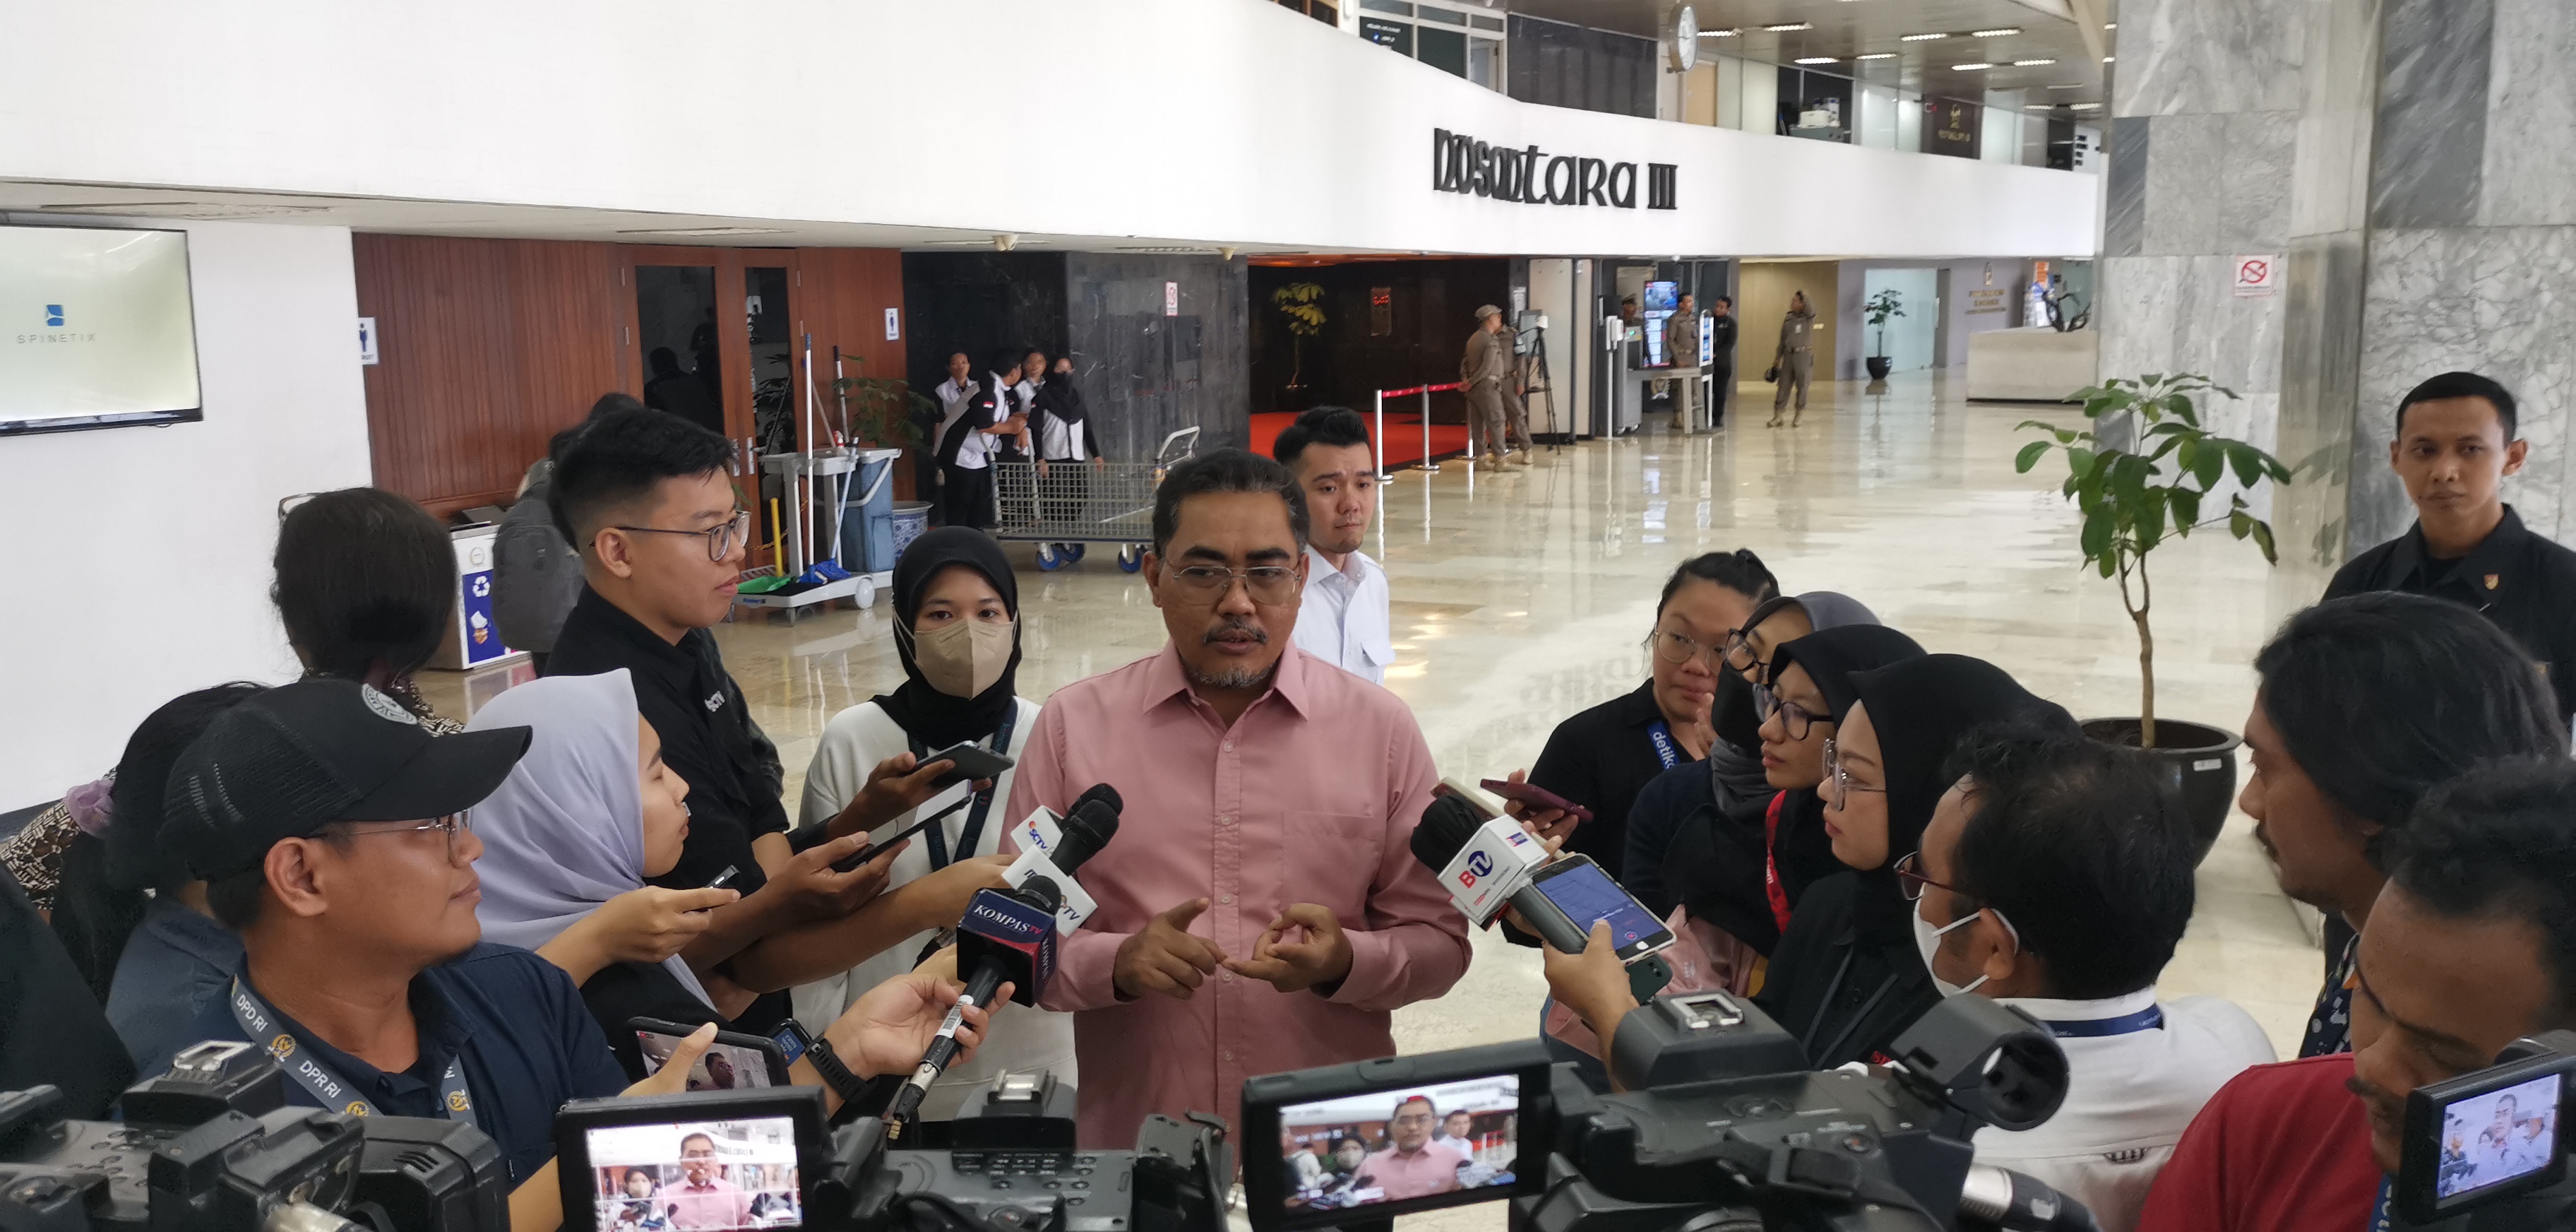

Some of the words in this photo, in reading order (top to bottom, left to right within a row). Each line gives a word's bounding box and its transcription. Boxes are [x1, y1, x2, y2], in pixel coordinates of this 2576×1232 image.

[1647, 162, 1678, 210] III
[17, 333, 96, 344] SPINETIX
[1029, 829, 1048, 849] SCTV
[974, 905, 1030, 933] KOMPAS
[237, 993, 256, 1020] DPD
[252, 1015, 268, 1032] RI
[299, 1060, 329, 1088] DPR
[323, 1082, 342, 1098] RI
